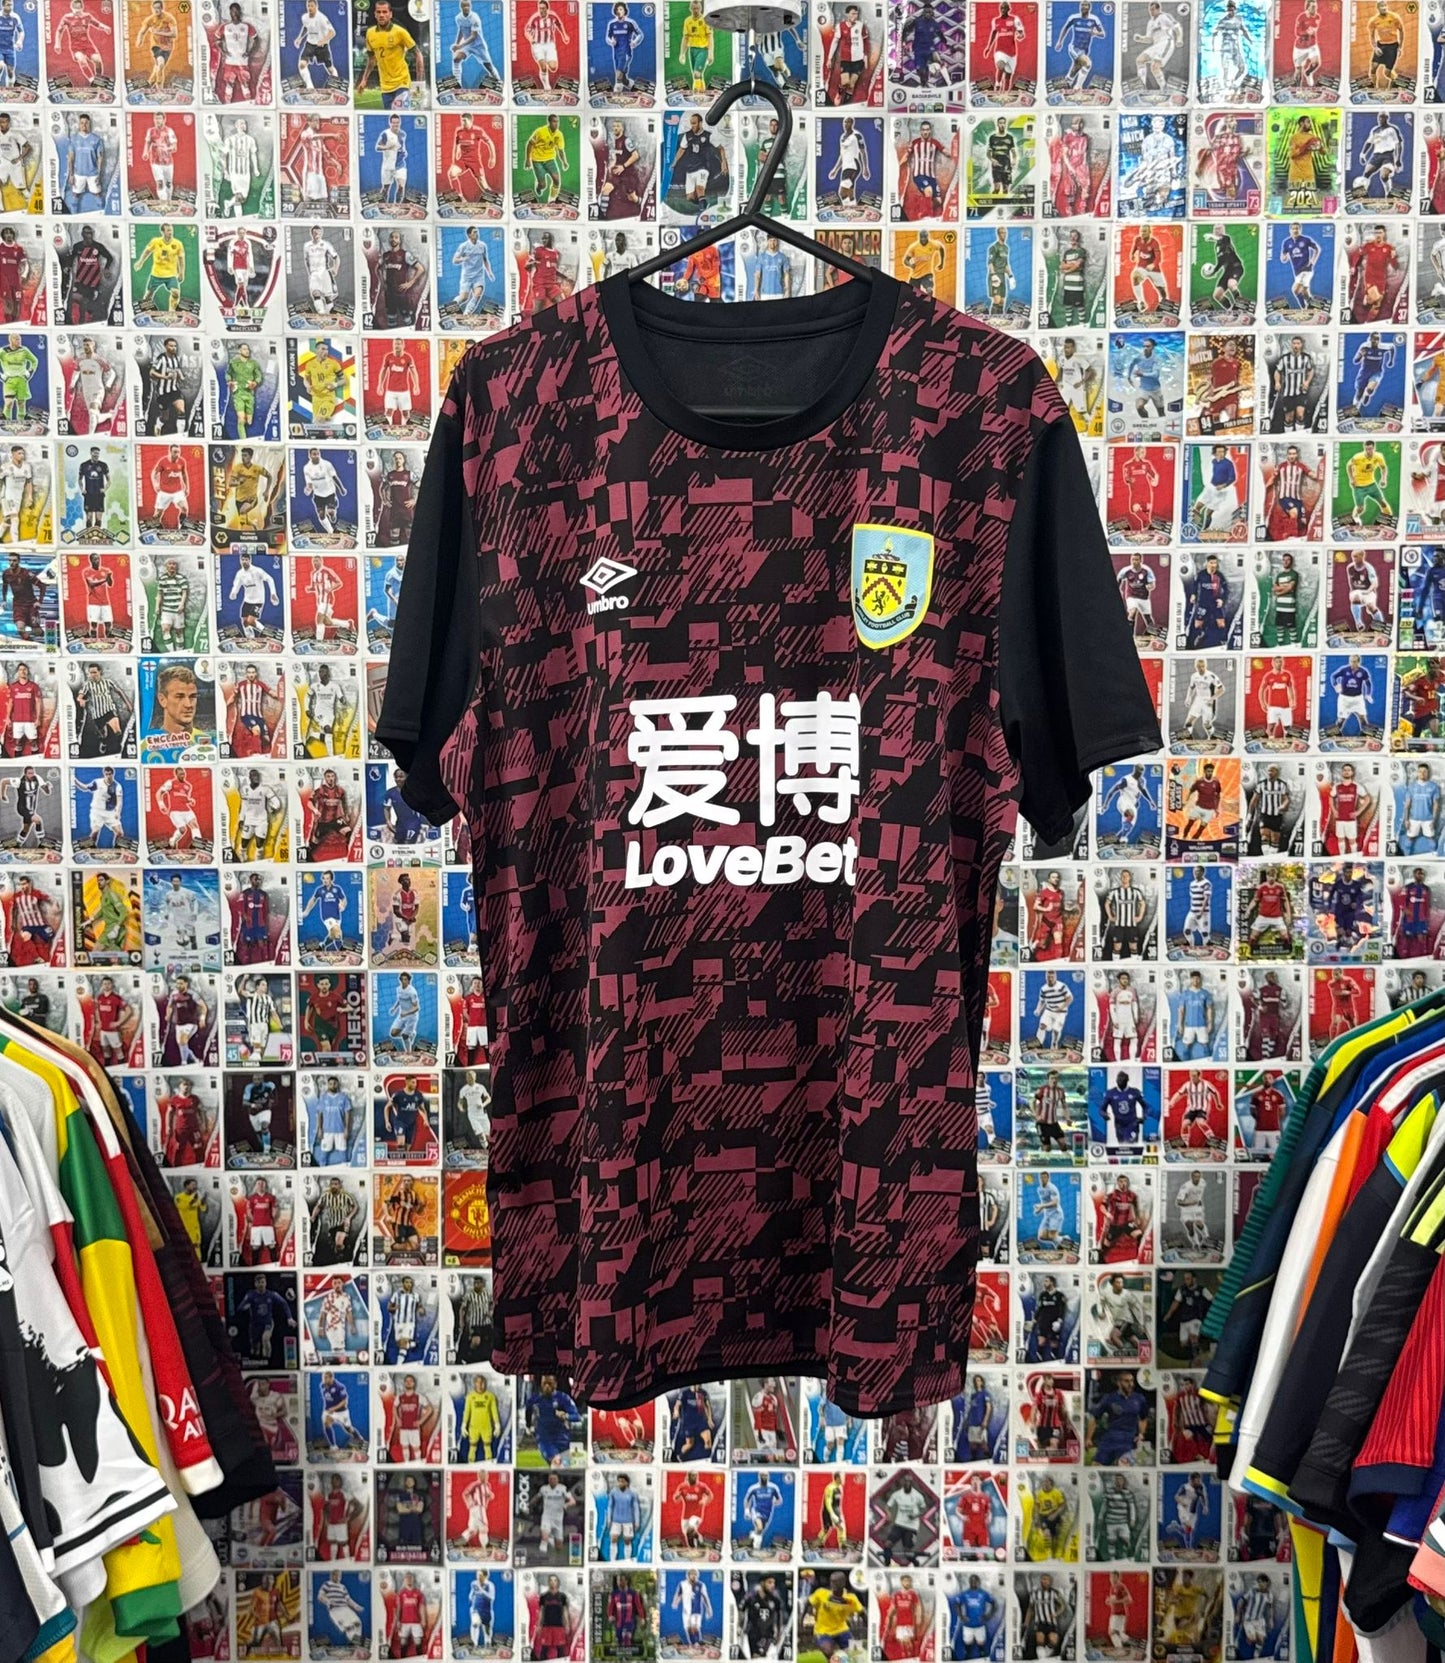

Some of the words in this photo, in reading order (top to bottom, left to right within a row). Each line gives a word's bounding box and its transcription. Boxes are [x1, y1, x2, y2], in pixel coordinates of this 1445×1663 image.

[1424, 88, 1434, 99] 73
[52, 199, 62, 210] 76
[1289, 191, 1318, 206] 2021
[282, 204, 294, 213] 20
[337, 204, 348, 213] 72
[1420, 199, 1430, 212] 77
[363, 315, 374, 326] 42
[1039, 314, 1048, 326] 55
[1398, 309, 1407, 320] 37
[421, 316, 430, 327] 77
[58, 420, 68, 432] 33
[136, 421, 146, 433] 65
[195, 422, 204, 434] 74
[213, 425, 222, 436] 78
[1317, 419, 1326, 430] 43
[214, 466, 226, 500] FIRE
[367, 533, 376, 545] 37
[587, 595, 629, 616] umbro
[142, 638, 152, 650] 46
[200, 638, 209, 650] 72
[146, 732, 192, 745] ENGLAND
[295, 744, 305, 756] 79
[351, 745, 360, 755] 72
[369, 744, 379, 755] 42
[627, 690, 862, 828] 爱博
[223, 848, 233, 859] 75
[298, 849, 307, 860] 70
[353, 847, 363, 858] 77
[1295, 843, 1304, 854] 77
[625, 835, 858, 889] LoveBet
[225, 951, 235, 963] 34
[347, 990, 361, 1049] HERO
[153, 1053, 163, 1065] 77
[228, 1049, 237, 1059] 45
[446, 1053, 456, 1065] 77
[211, 1153, 220, 1165] 77
[159, 1385, 200, 1431] QA
